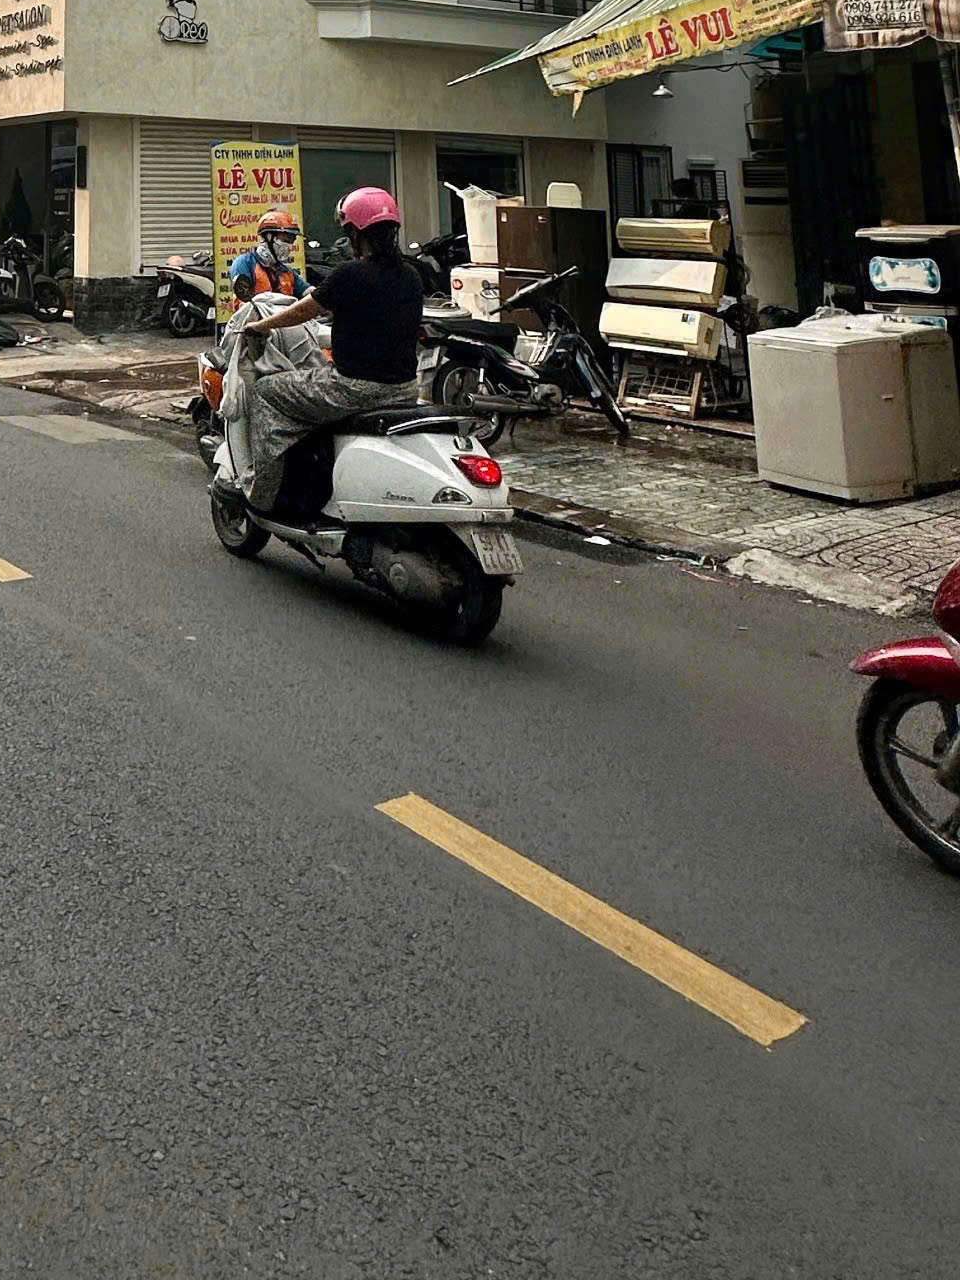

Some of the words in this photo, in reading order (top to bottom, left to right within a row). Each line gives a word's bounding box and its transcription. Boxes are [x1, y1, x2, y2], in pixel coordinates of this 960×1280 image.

[14, 4, 51, 31] SALON
[644, 17, 682, 60] LÊ
[680, 7, 737, 48] VUI
[214, 149, 229, 160] CTY
[231, 149, 253, 160] TNHH
[216, 162, 247, 190] LÊ
[251, 167, 296, 190] VUI
